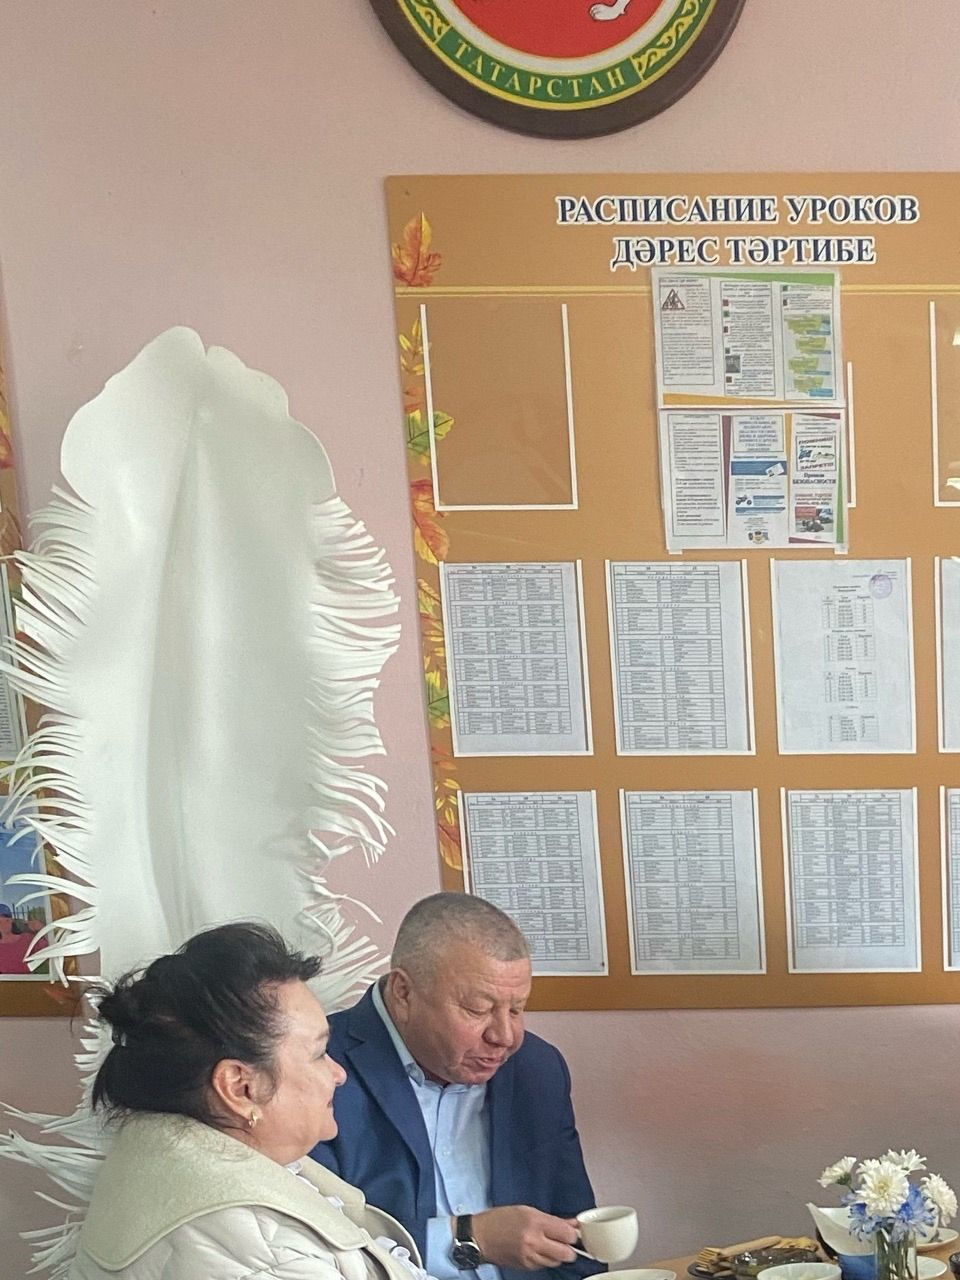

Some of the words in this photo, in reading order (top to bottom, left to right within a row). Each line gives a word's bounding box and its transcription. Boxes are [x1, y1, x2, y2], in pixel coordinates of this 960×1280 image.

[453, 38, 626, 98] ТАТАРСТАН
[559, 198, 777, 222] РАСПИСАНИЕ
[789, 198, 919, 222] УРОКОВ
[612, 239, 718, 269] ДӘРЕС
[726, 238, 875, 263] ТӘРТИБЕ
